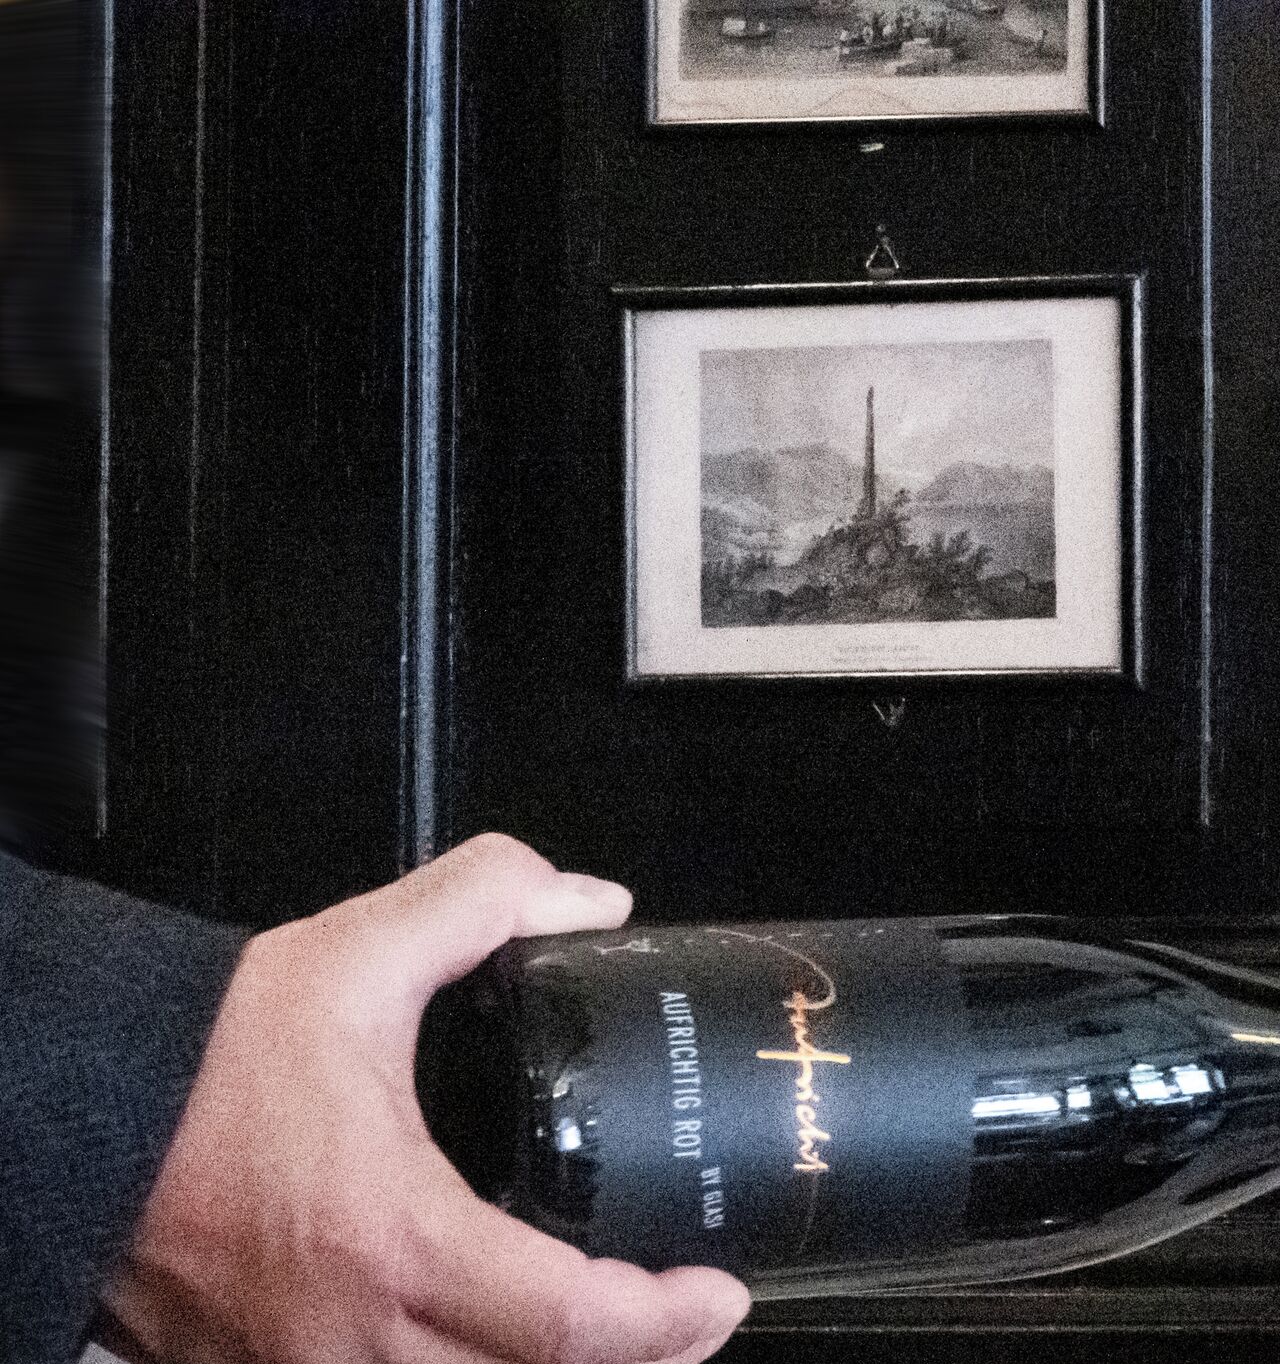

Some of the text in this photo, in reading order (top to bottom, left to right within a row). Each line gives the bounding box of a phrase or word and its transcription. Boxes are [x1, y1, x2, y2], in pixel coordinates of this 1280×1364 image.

[659, 991, 703, 1159] AUFRICHTIG ROT
[700, 1166, 721, 1187] BY
